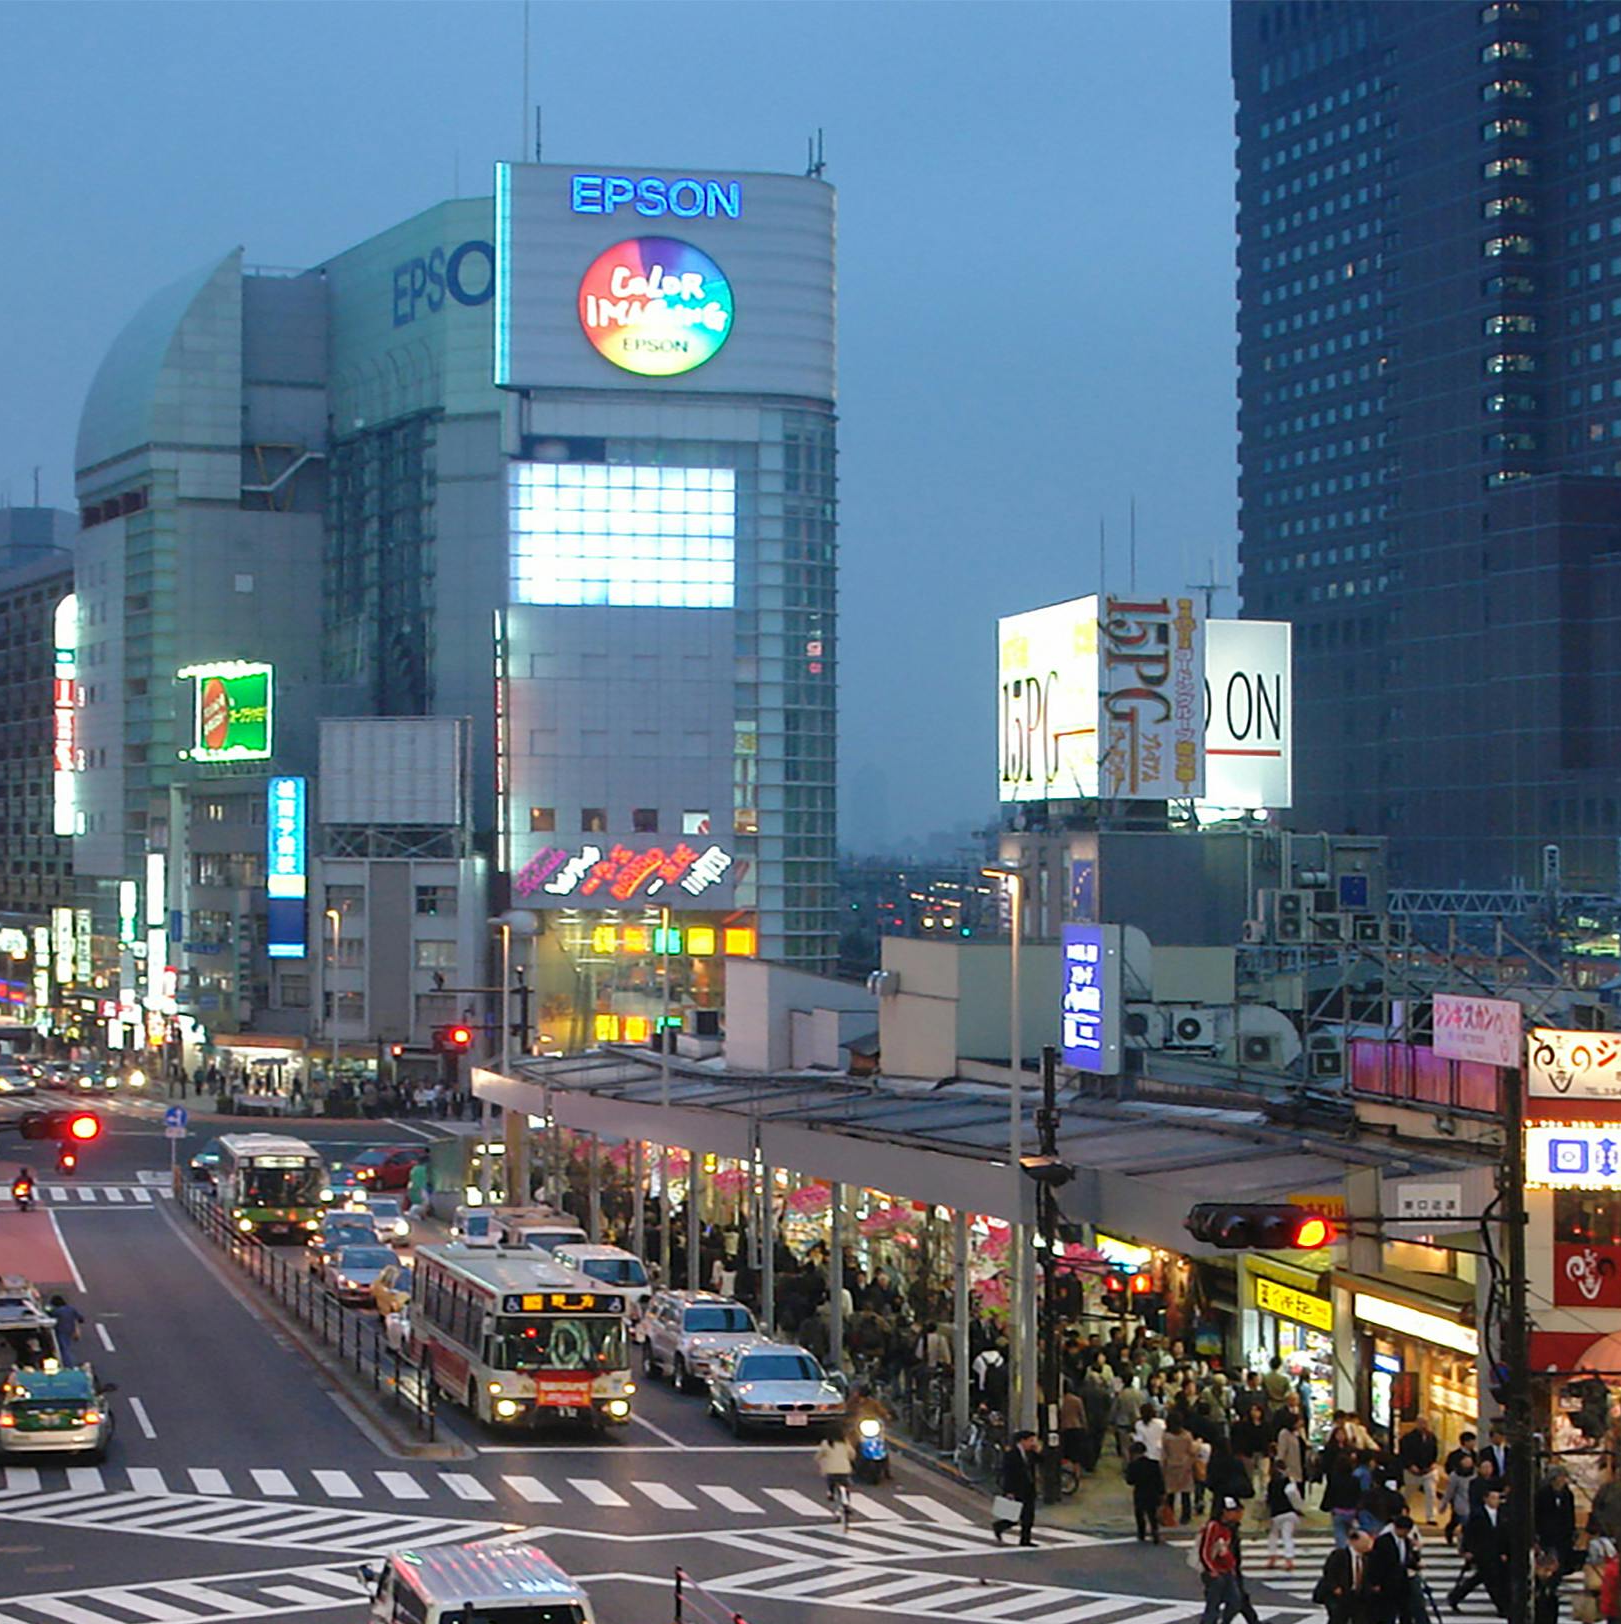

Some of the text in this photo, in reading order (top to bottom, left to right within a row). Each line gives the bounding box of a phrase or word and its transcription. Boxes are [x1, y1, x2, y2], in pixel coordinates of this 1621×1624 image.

[570, 174, 742, 218] EPSON
[622, 336, 690, 354] EPSON
[1227, 670, 1281, 741] ON
